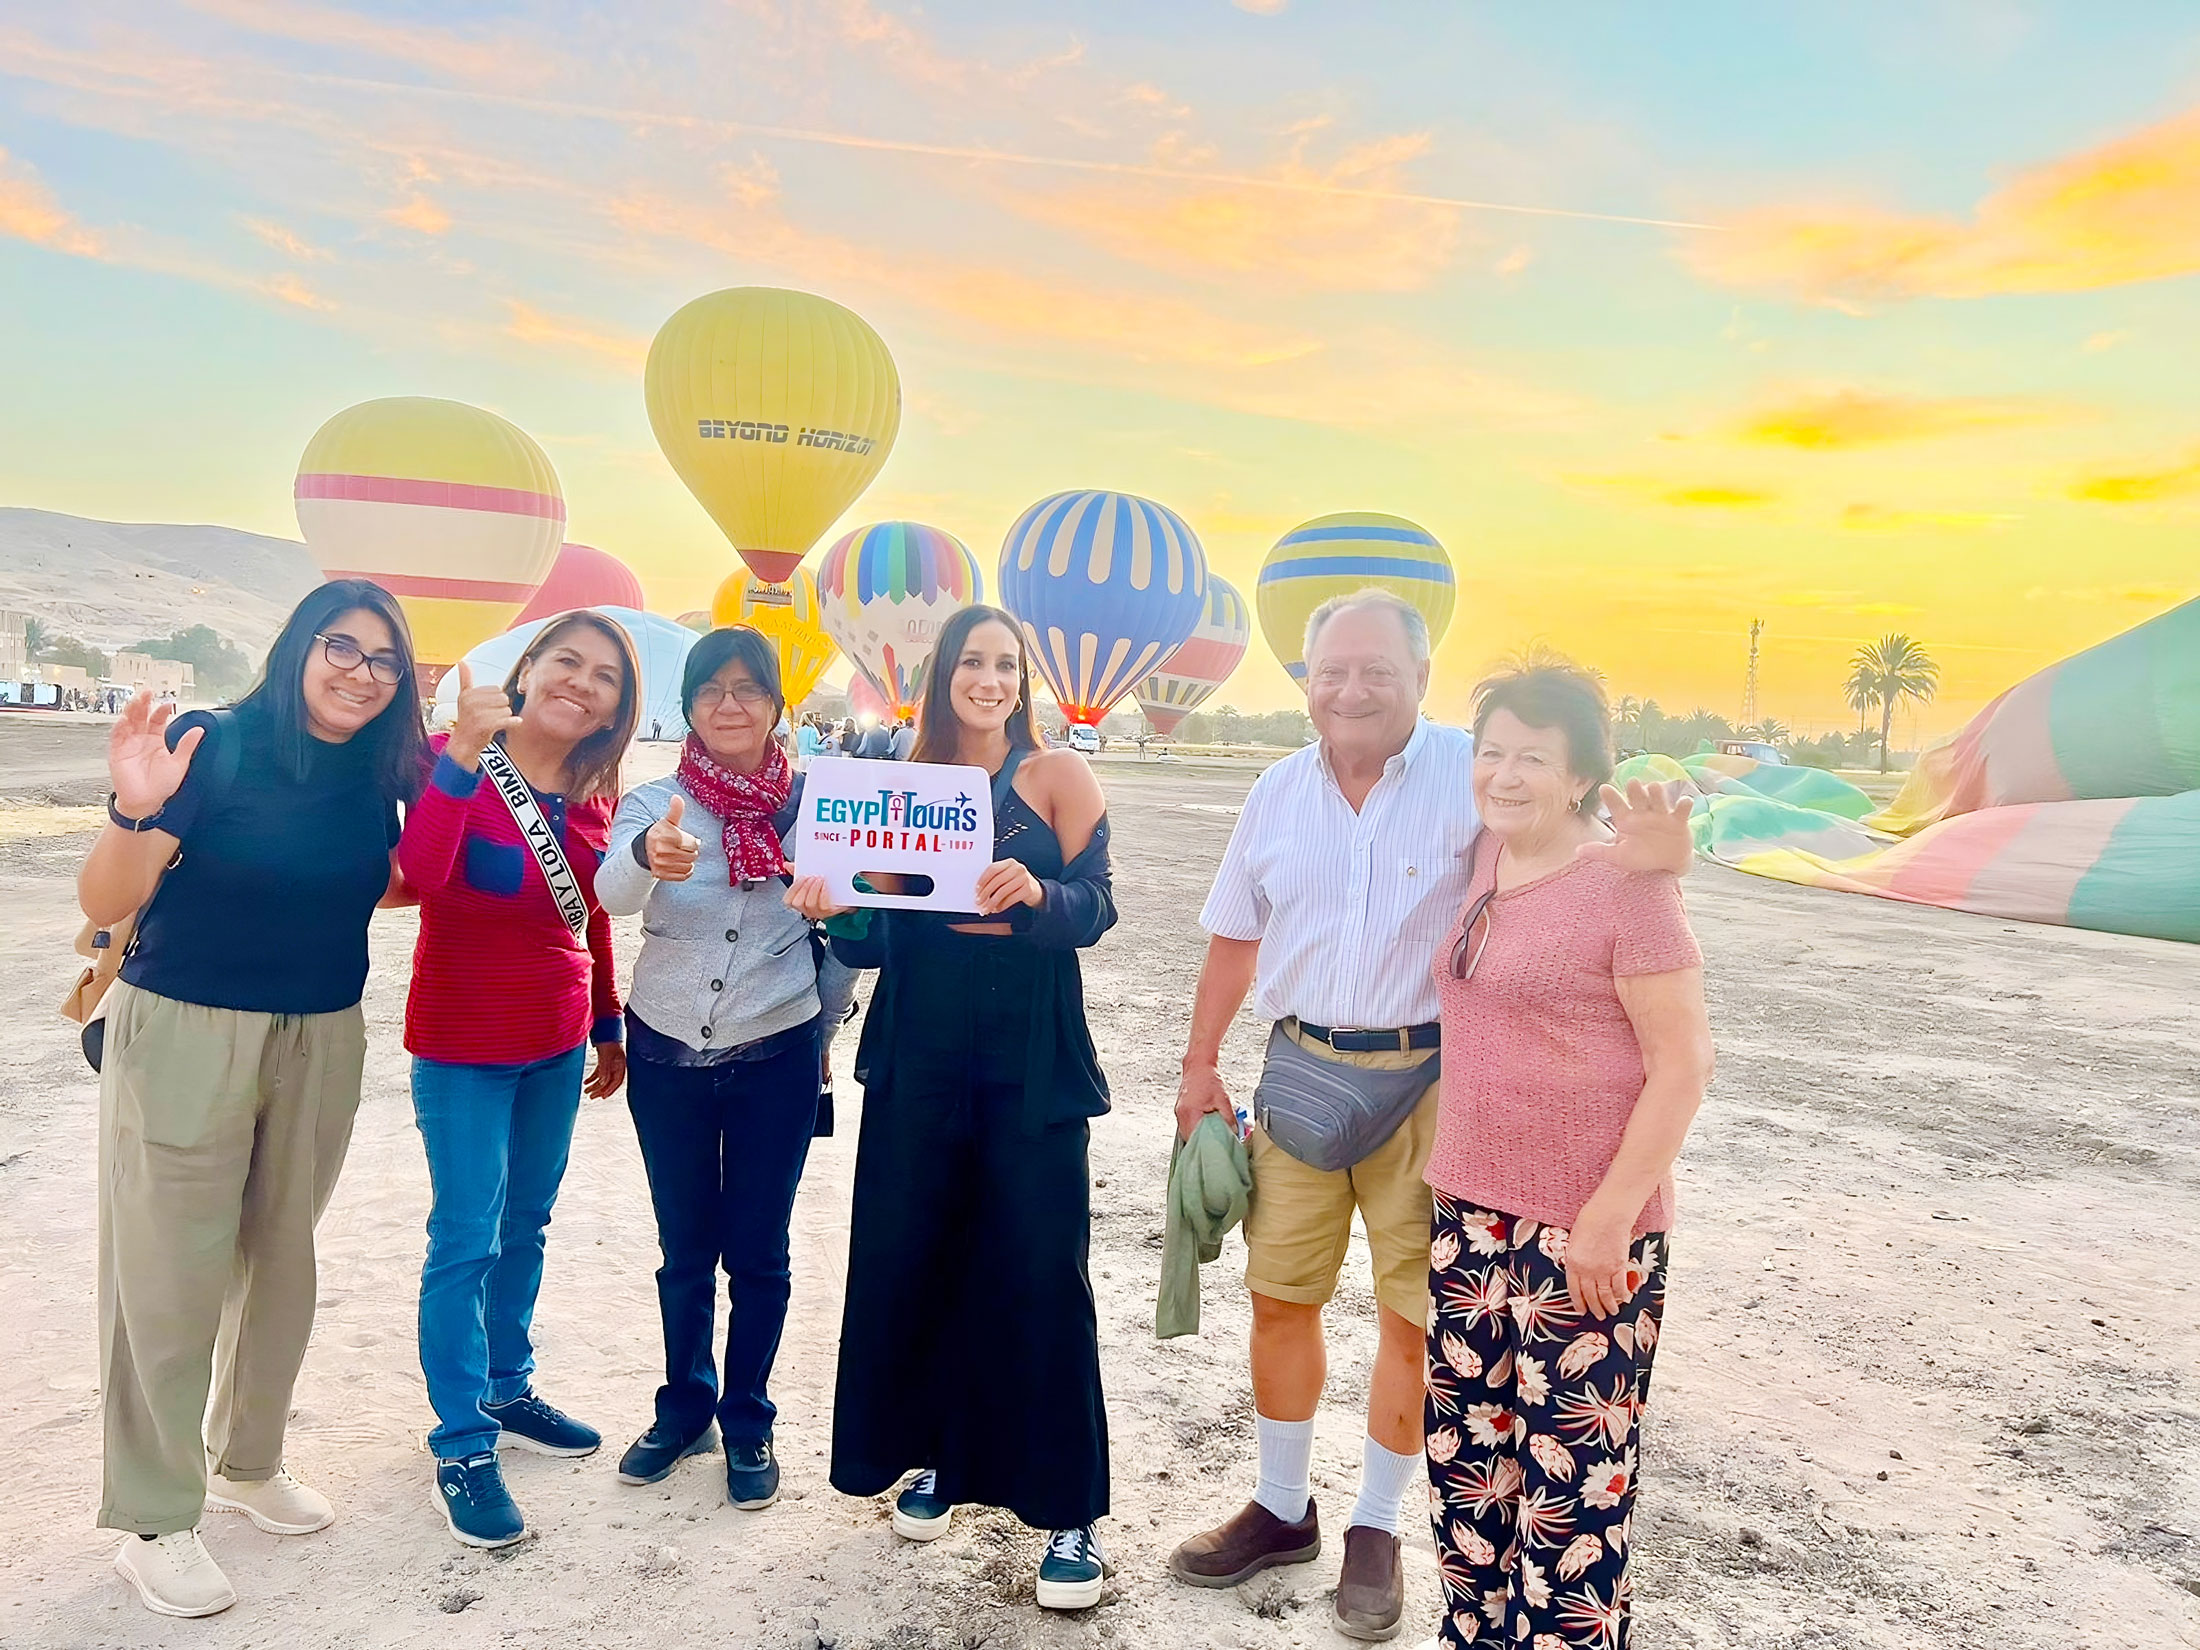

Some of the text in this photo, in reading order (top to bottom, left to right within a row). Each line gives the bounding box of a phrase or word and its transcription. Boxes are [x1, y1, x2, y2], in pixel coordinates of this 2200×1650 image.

[698, 419, 790, 443] BEYOND
[816, 789, 978, 832] EGYPT TOURS
[528, 819, 565, 878] LOLA
[850, 828, 942, 853] PORTAL
